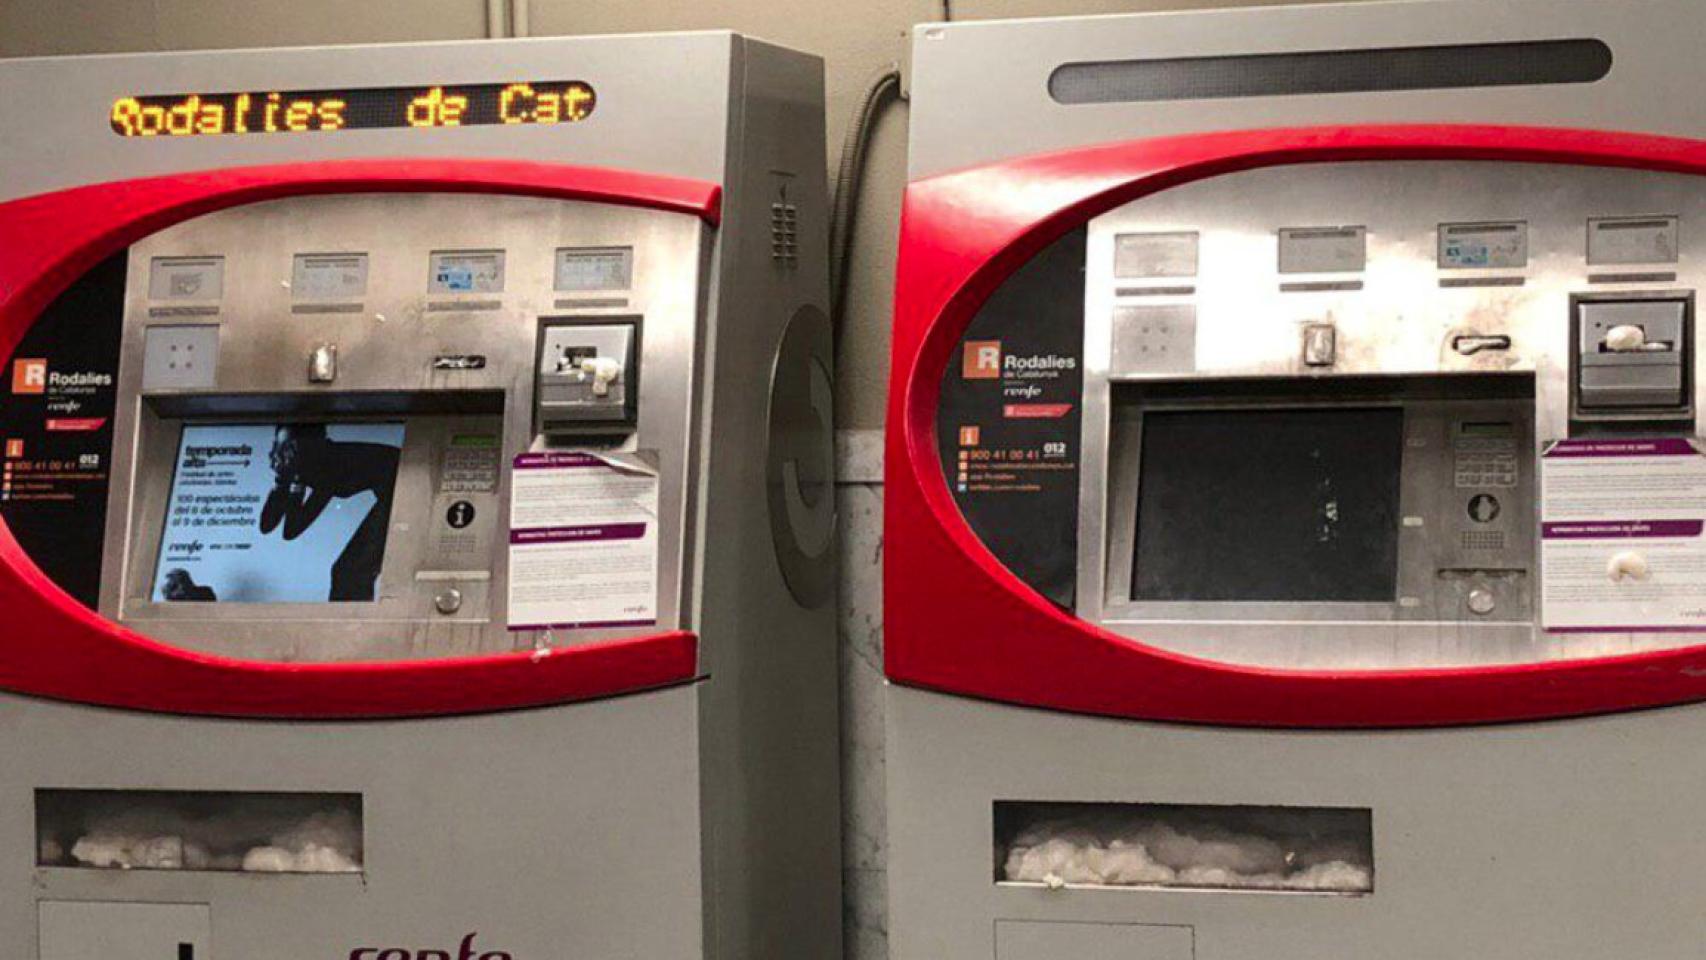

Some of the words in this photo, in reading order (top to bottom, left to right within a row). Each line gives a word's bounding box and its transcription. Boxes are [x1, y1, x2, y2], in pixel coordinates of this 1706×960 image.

[111, 93, 345, 137] Rodalies
[407, 86, 467, 127] de
[500, 83, 593, 124] Cat
[977, 347, 997, 369] R
[1004, 355, 1075, 369] Rodalies
[25, 363, 45, 386] R
[50, 371, 111, 385] Rodalies
[1004, 385, 1042, 399] renfe
[1044, 442, 1066, 454] 012
[79, 454, 99, 464] 012
